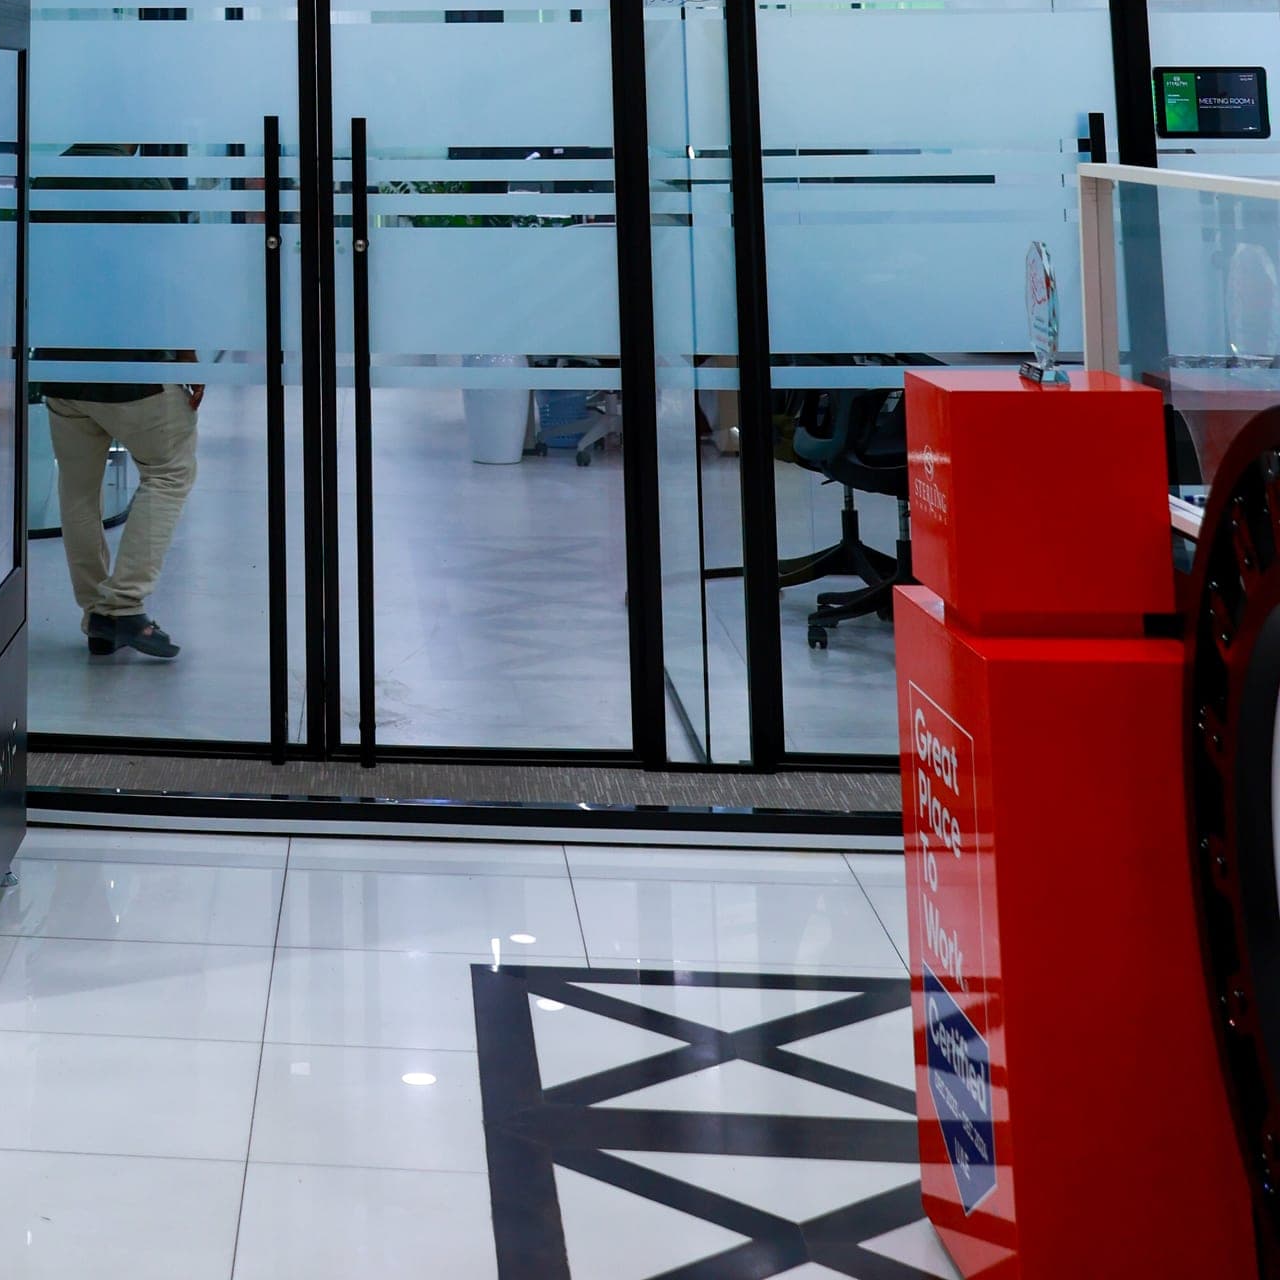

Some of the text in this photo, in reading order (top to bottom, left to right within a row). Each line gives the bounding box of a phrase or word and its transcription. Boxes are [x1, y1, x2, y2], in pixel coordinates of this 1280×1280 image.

[1199, 97, 1229, 105] MEETING
[1229, 97, 1251, 105] ROOM
[914, 707, 960, 797] Great
[918, 767, 961, 858] Place
[920, 830, 938, 893] To
[928, 996, 987, 1116] Certified
